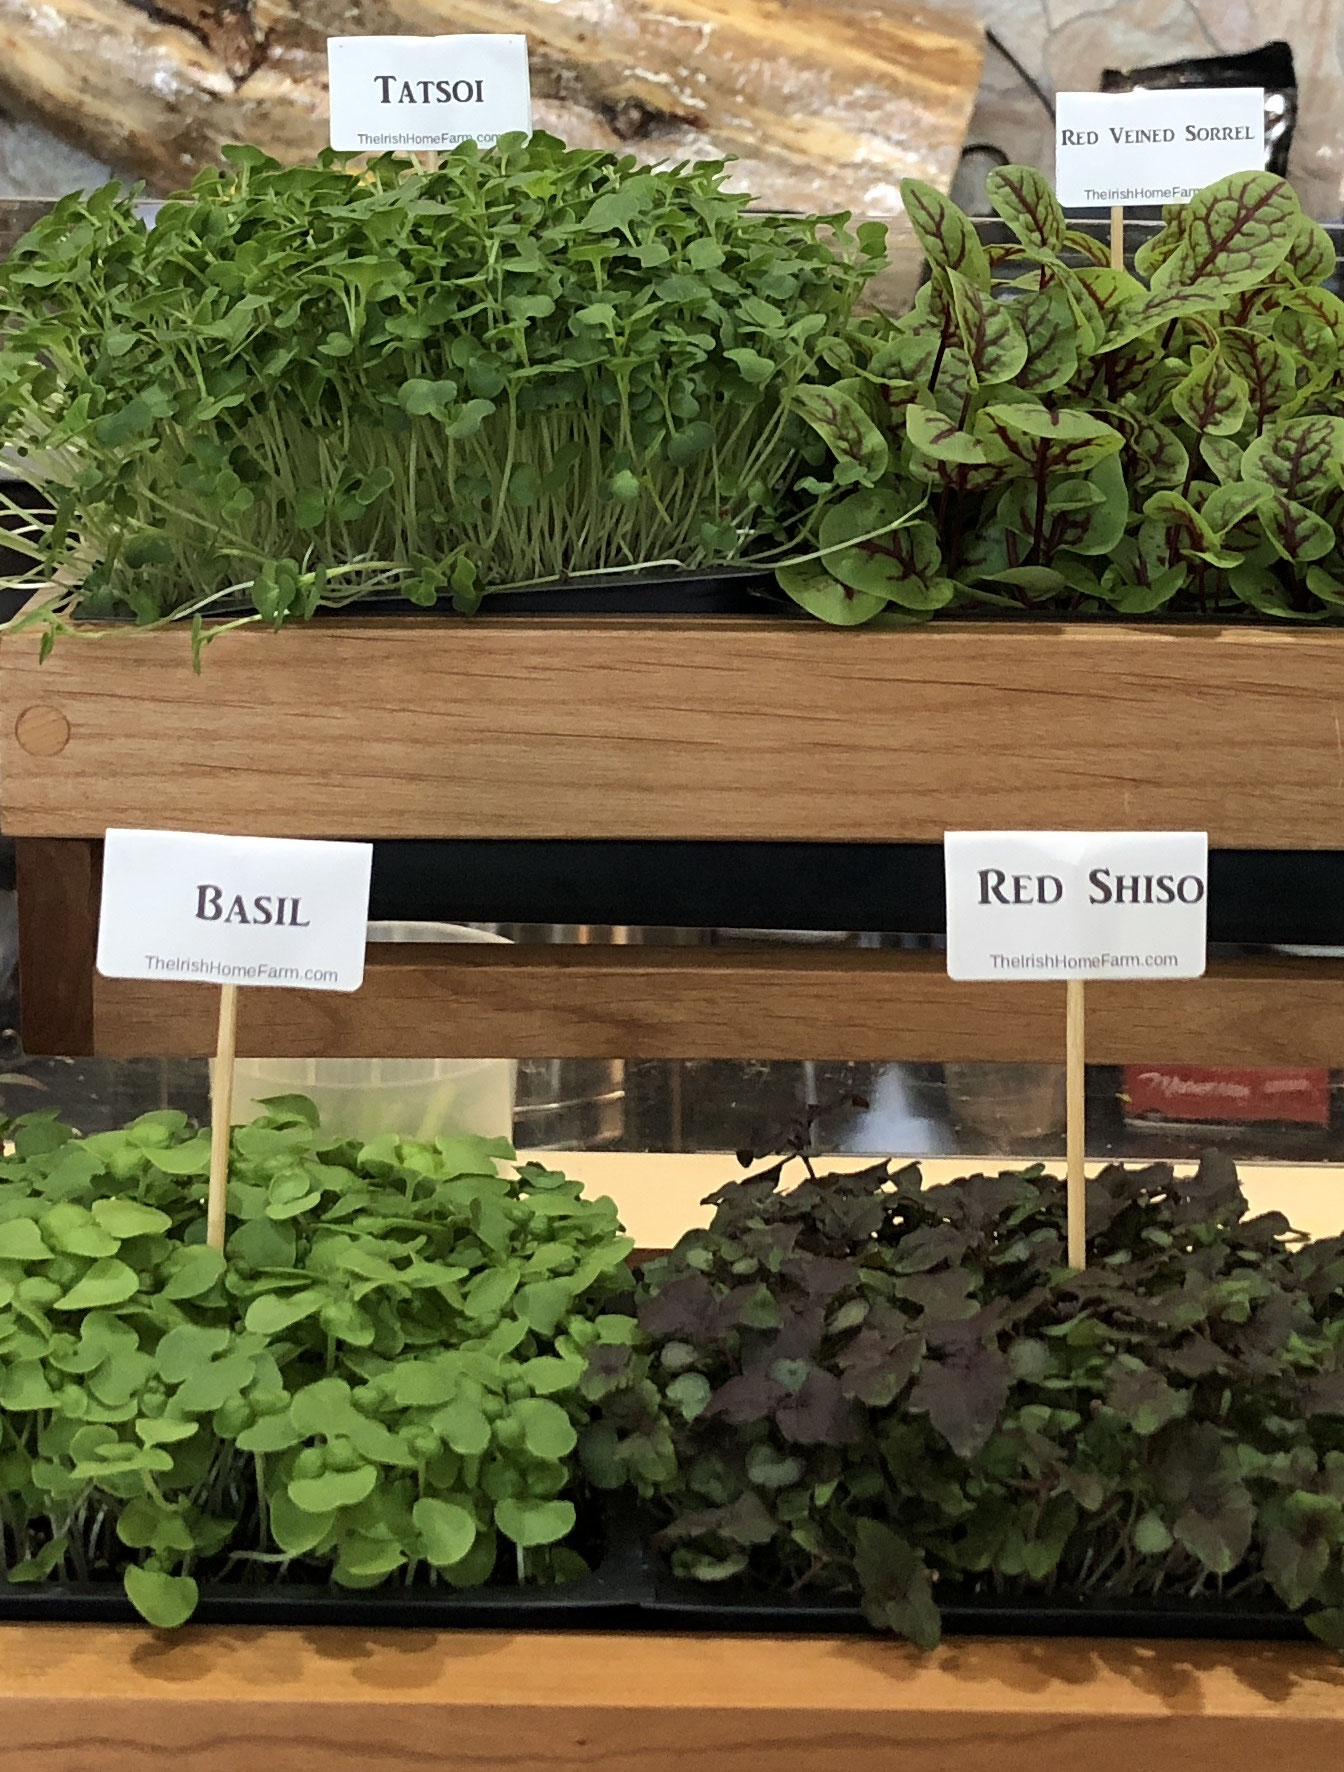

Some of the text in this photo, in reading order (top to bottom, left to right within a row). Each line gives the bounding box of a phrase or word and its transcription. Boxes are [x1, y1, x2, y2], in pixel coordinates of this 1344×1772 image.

[373, 75, 485, 105] TATSOI
[357, 132, 501, 146] TheIrishHomeFarmco
[1061, 124, 1256, 146] RED VEINED SORREL
[976, 867, 1205, 906] RED SHISO
[195, 883, 311, 928] BASIL
[144, 954, 339, 984] TheIrishHomeFarm.com
[989, 952, 1179, 969] TheIrishHomeFarm.com
